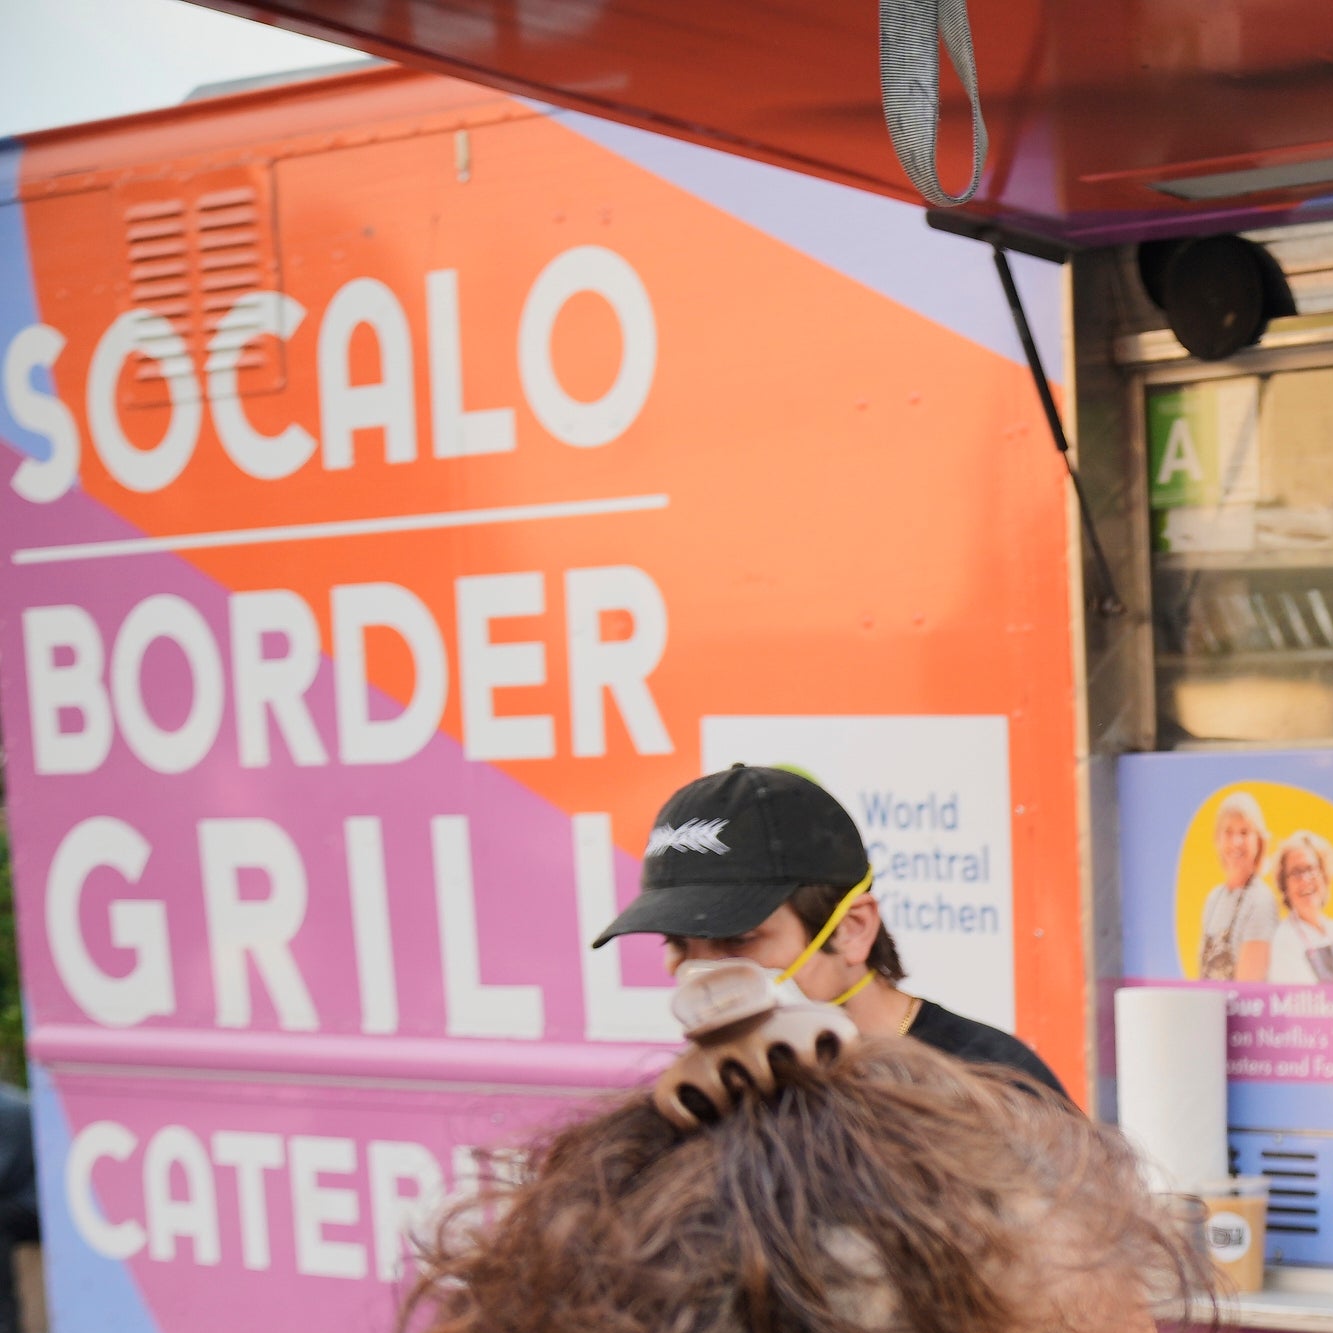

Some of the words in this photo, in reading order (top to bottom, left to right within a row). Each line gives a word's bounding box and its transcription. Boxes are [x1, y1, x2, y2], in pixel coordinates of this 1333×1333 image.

[4, 244, 658, 503] SOCALO
[1157, 417, 1204, 485] A
[22, 563, 675, 775] BORDER
[860, 792, 958, 830] World
[46, 812, 686, 1041] GRILL
[1276, 1055, 1310, 1077] and
